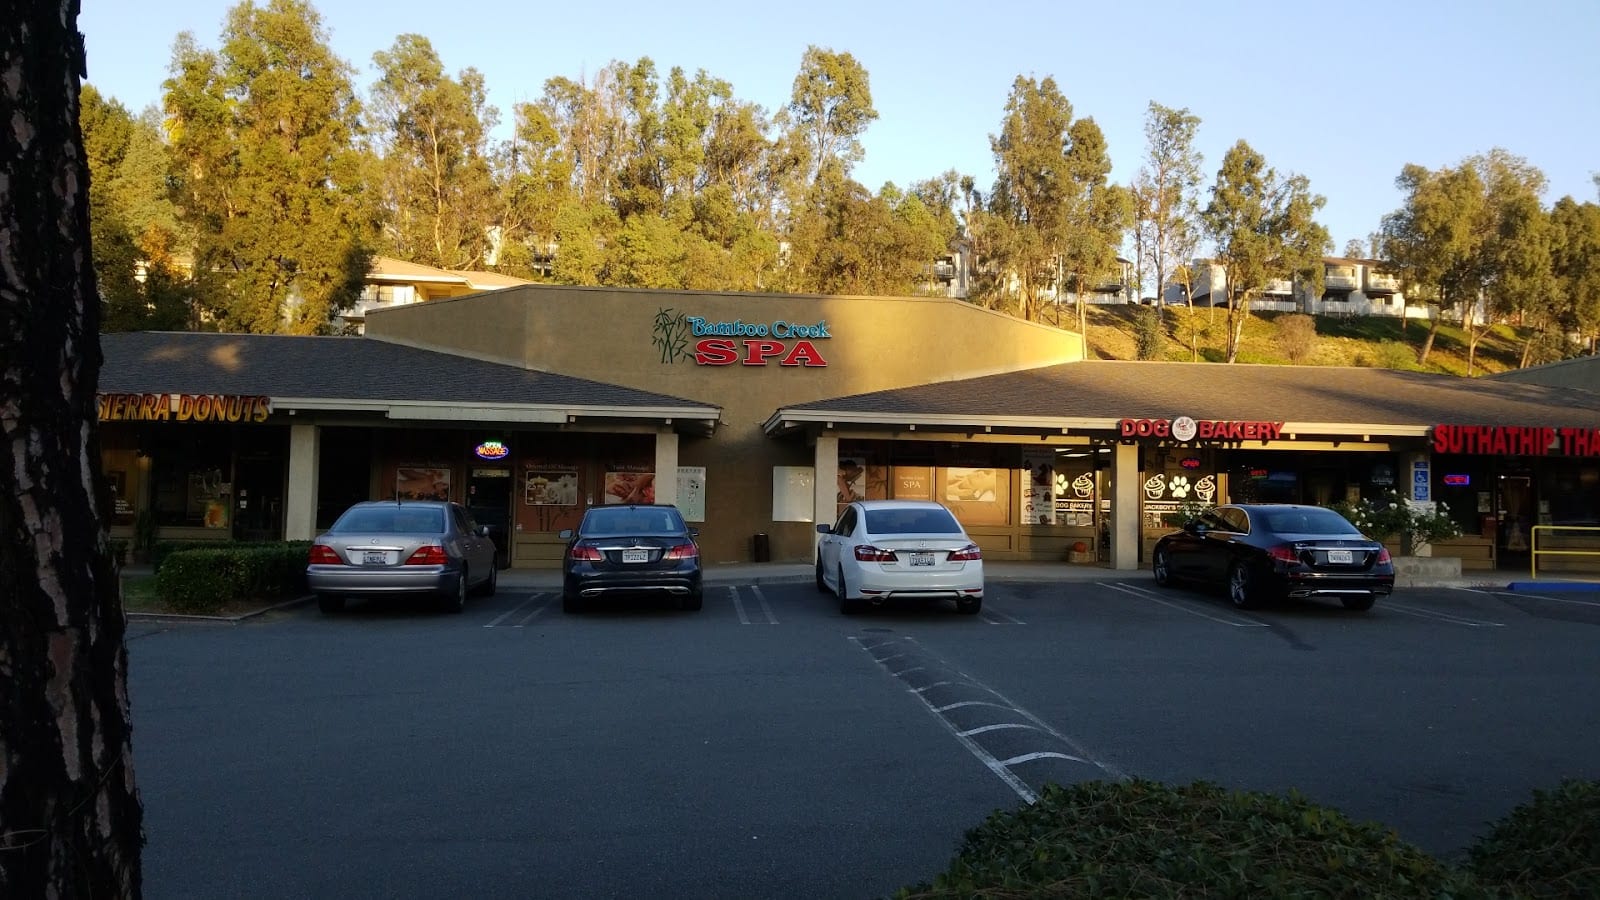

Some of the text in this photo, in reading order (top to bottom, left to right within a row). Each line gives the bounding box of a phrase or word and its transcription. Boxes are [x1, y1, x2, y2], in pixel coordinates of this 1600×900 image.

[687, 316, 832, 338] Bamboo Creek
[694, 339, 828, 367] SPA
[97, 393, 269, 422] SIERRA DONUTS
[1120, 418, 1283, 440] DOG BAKERY
[1434, 424, 1555, 456] SUTHATHIP
[478, 446, 507, 456] MASSAGE
[903, 480, 921, 489] SPA
